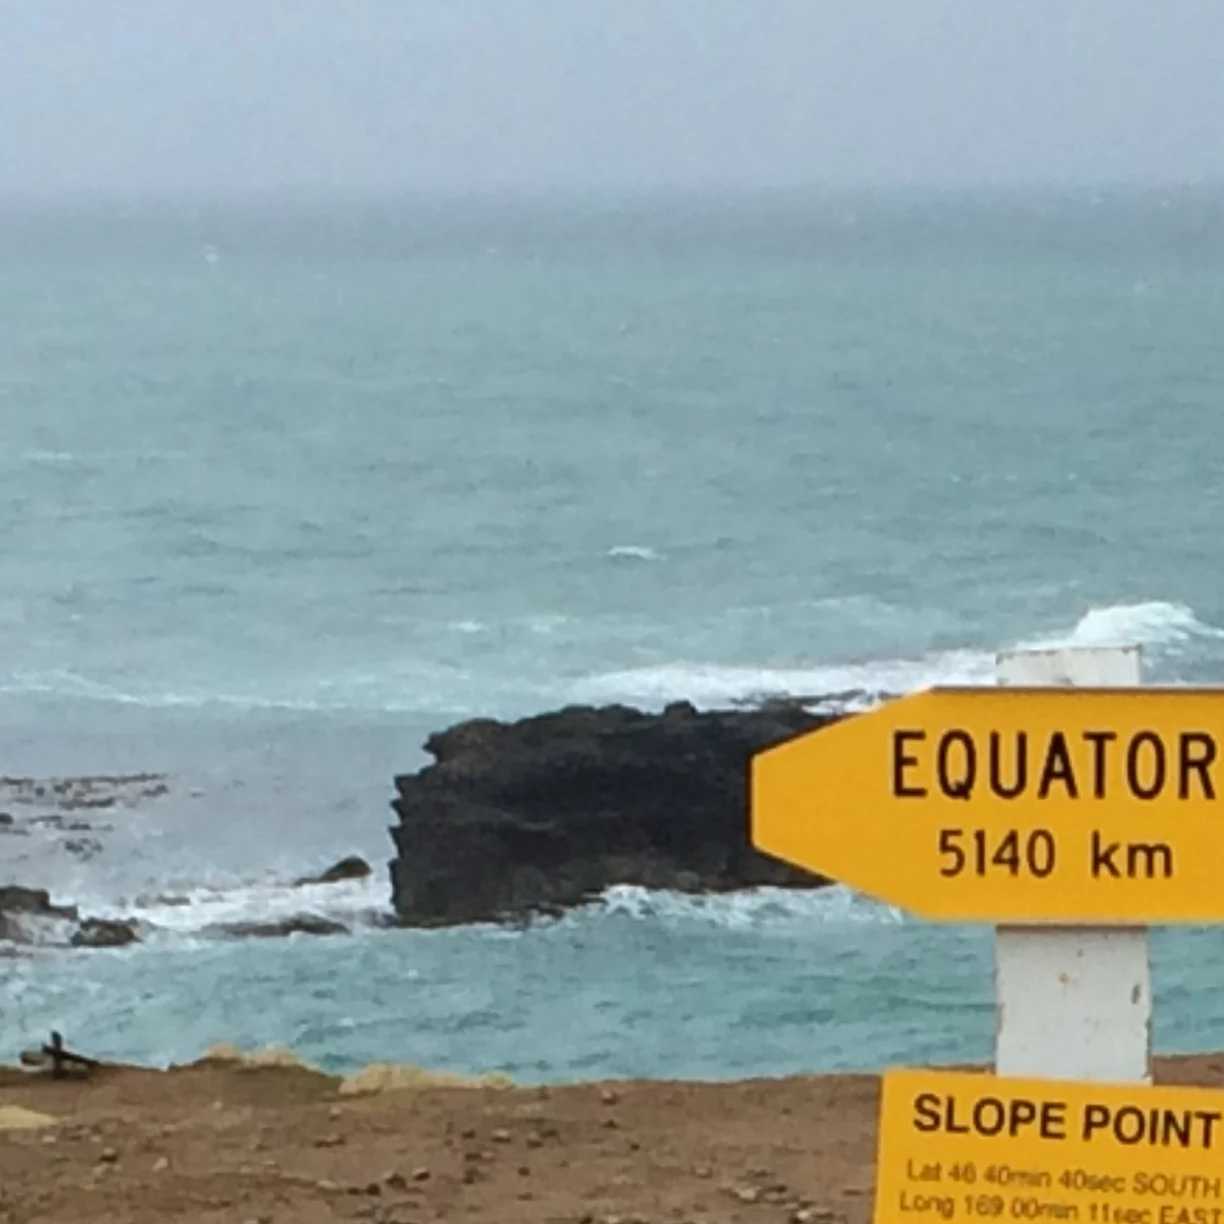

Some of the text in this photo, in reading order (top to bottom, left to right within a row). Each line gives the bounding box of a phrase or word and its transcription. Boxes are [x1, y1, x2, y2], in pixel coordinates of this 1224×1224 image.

[890, 730, 1218, 802] EQUATOR
[938, 829, 1175, 879] 5140 km
[914, 1093, 1222, 1148] SLOPE POINT
[907, 1159, 1221, 1198] Lat 46 40min 40sec SOUTH
[900, 1191, 954, 1219] Long
[964, 1194, 1001, 1217] 169
[1011, 1196, 1078, 1221] 00min
